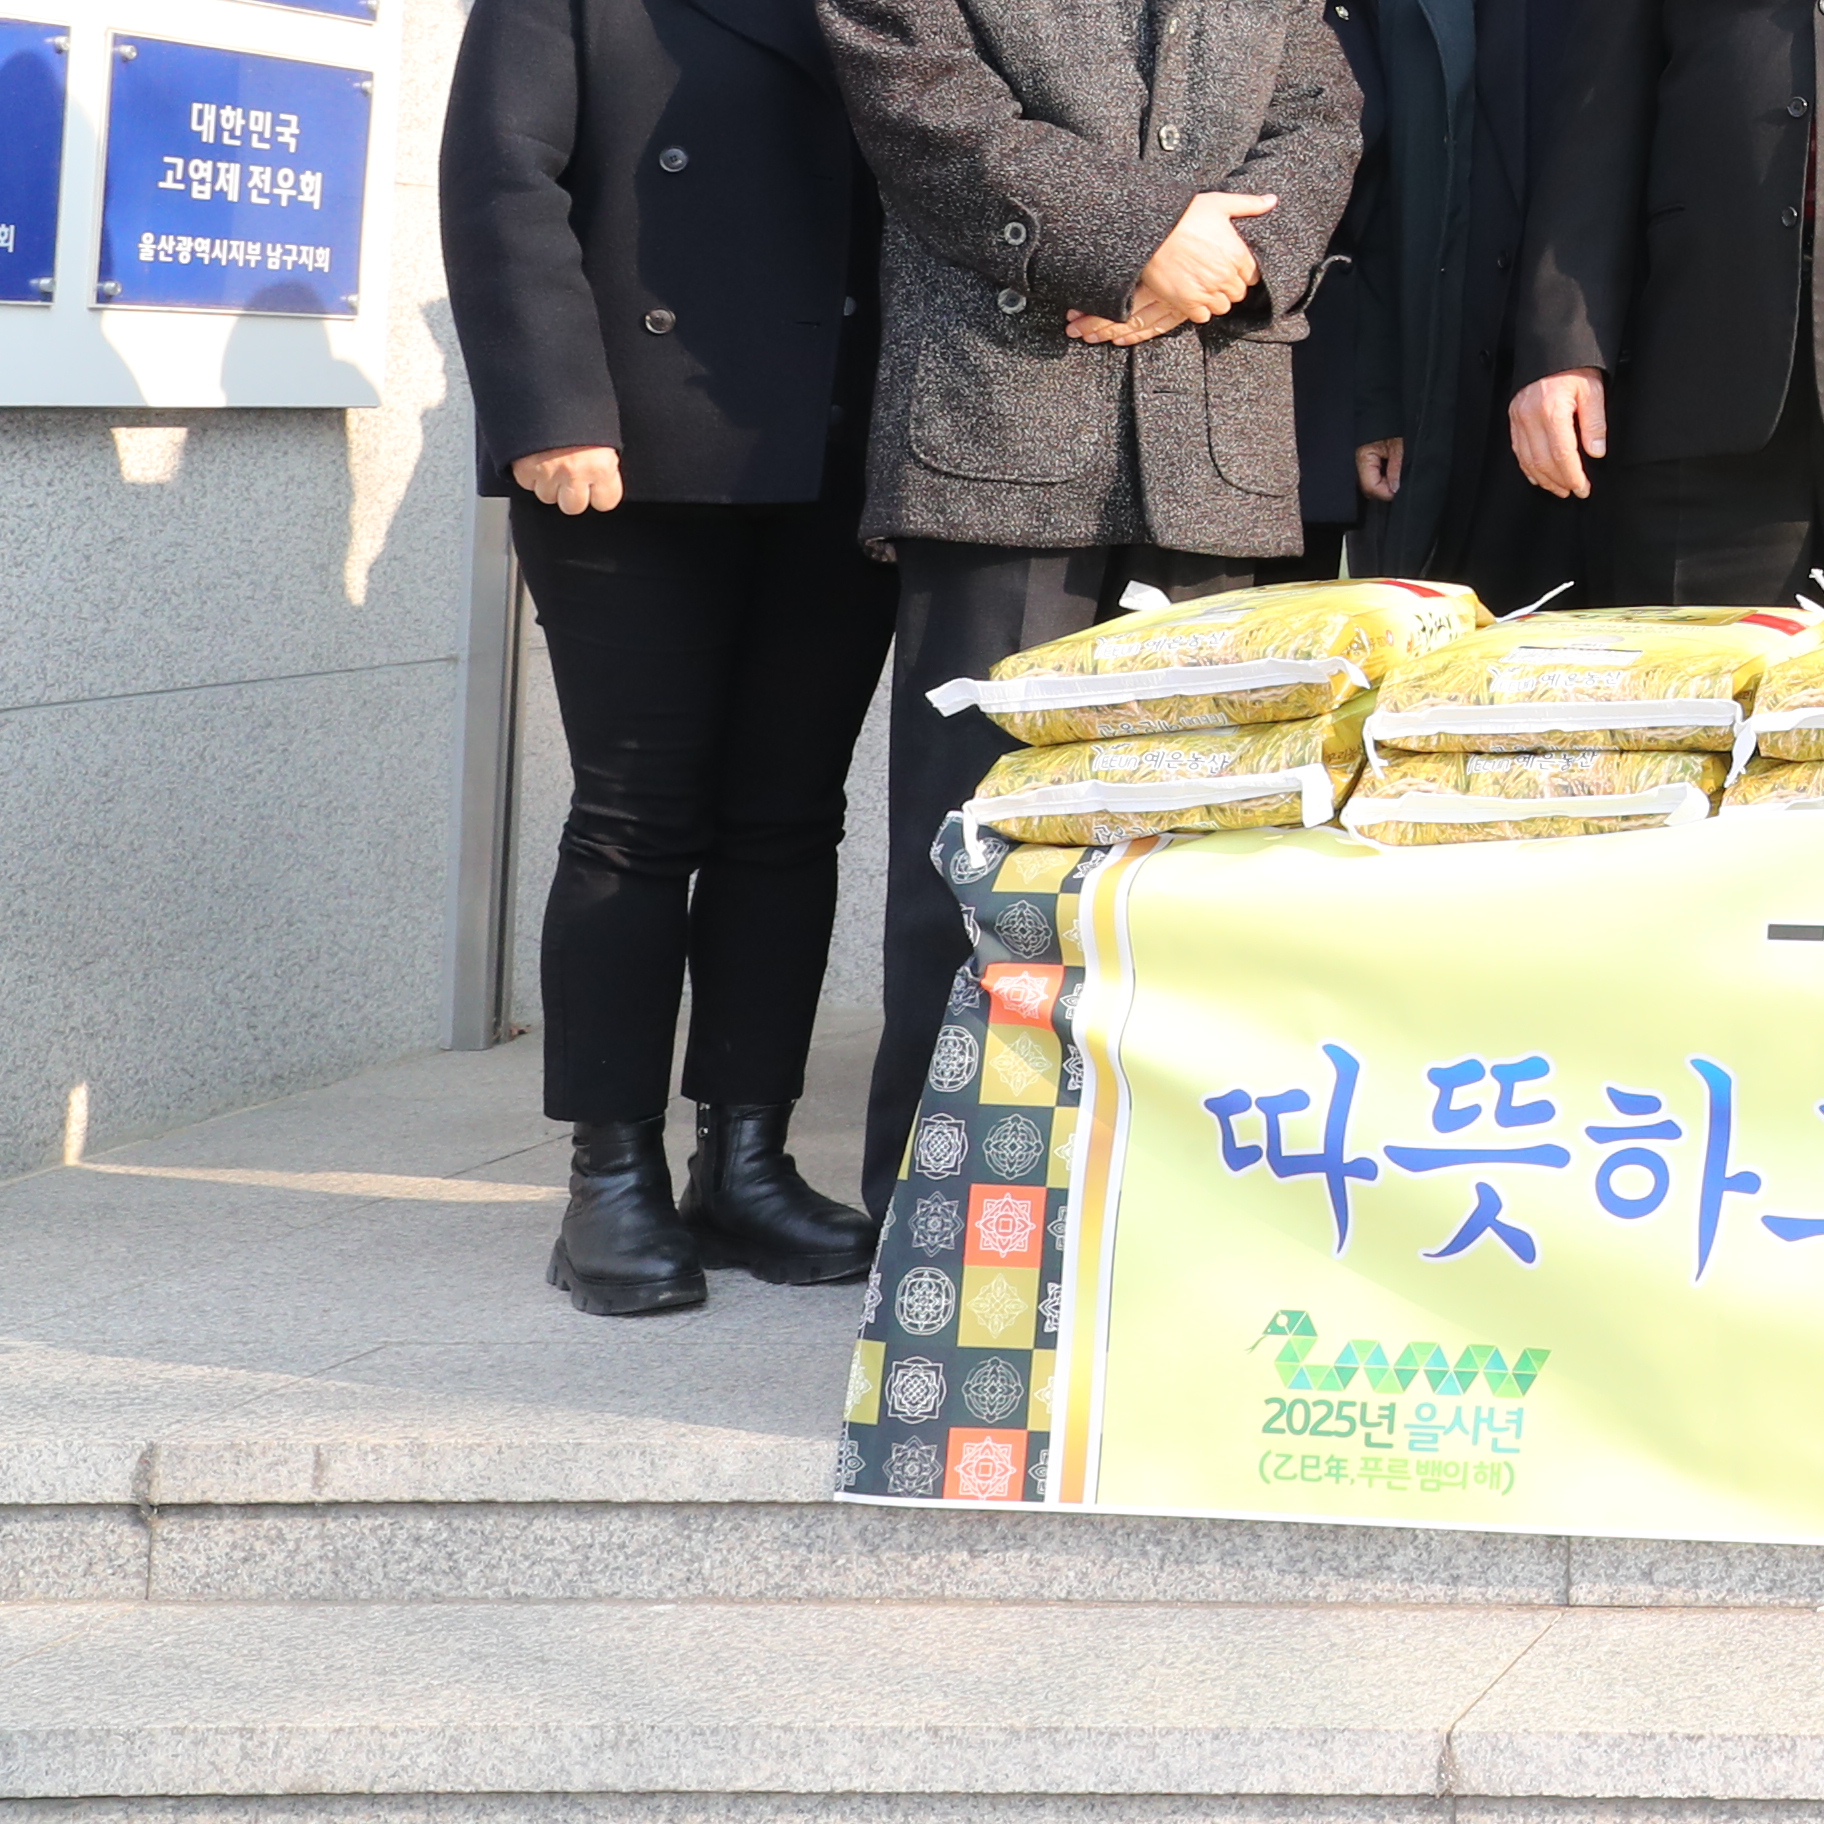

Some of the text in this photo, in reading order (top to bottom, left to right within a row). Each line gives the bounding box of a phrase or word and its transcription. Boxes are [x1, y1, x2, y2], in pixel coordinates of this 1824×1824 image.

[190, 101, 301, 154] 대한민국
[157, 155, 324, 210] 고엽제 전우회
[137, 231, 331, 273] 울산광역시지부 남구지회
[1142, 750, 1231, 775] 예은농산
[1261, 1396, 1525, 1455] 2025년 을사년
